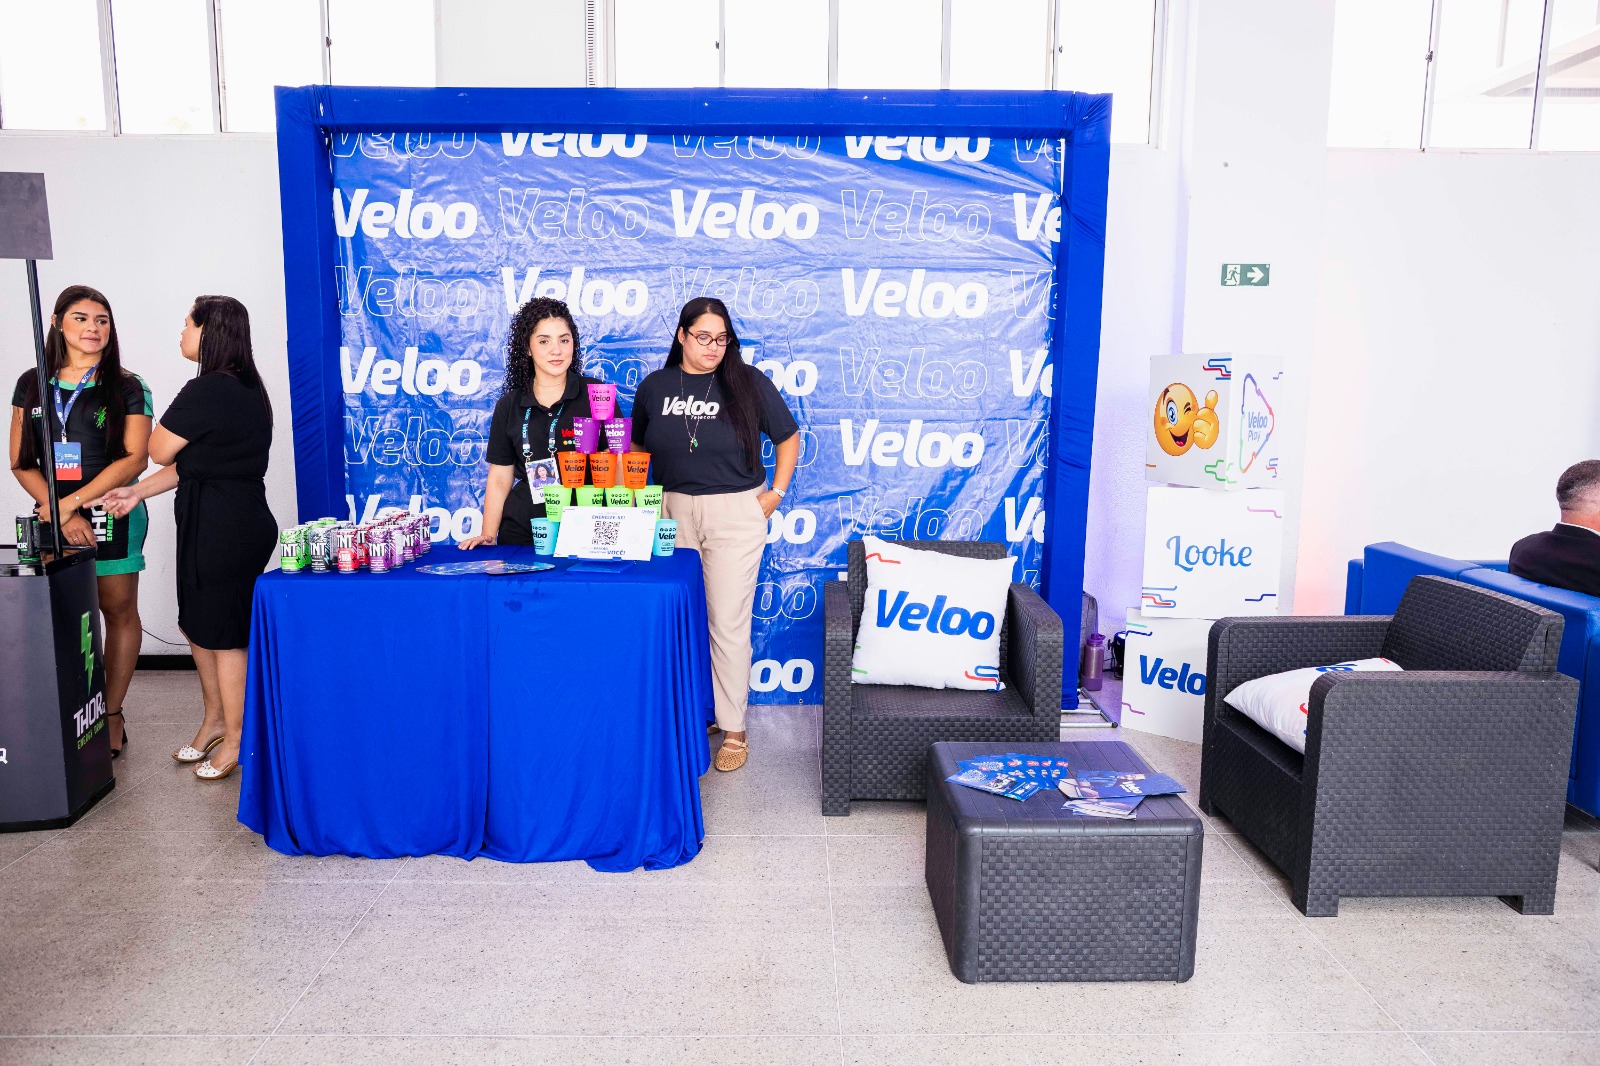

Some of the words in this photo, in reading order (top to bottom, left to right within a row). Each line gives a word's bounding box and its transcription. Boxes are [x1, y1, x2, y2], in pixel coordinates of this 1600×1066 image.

[501, 133, 648, 158] Veloo
[845, 136, 991, 162] Veloo
[333, 188, 478, 239] Veloo
[499, 188, 649, 240] Veloo
[670, 188, 820, 240] Veloo
[841, 190, 992, 242] Veloo
[335, 266, 481, 317] Veloo
[501, 266, 649, 317] Veloo
[670, 266, 820, 318] Veloo
[841, 268, 989, 319] Veloo
[340, 346, 482, 396] Veloo
[839, 347, 988, 398] Veloo
[662, 395, 720, 416] Veloo
[1247, 411, 1268, 429] Veloo
[343, 416, 484, 466] Veloo
[561, 428, 575, 438] Vel
[840, 418, 985, 468] Veloo
[91, 502, 107, 542] THO
[106, 513, 114, 542] ENERG
[337, 534, 354, 548] TNT
[531, 531, 548, 539] eloo
[837, 496, 985, 543] Veloo
[369, 542, 387, 557] TNT
[1166, 535, 1253, 572] Looke
[875, 589, 995, 641] Veloo
[1139, 654, 1206, 696] Velo
[73, 691, 103, 738] THOR
